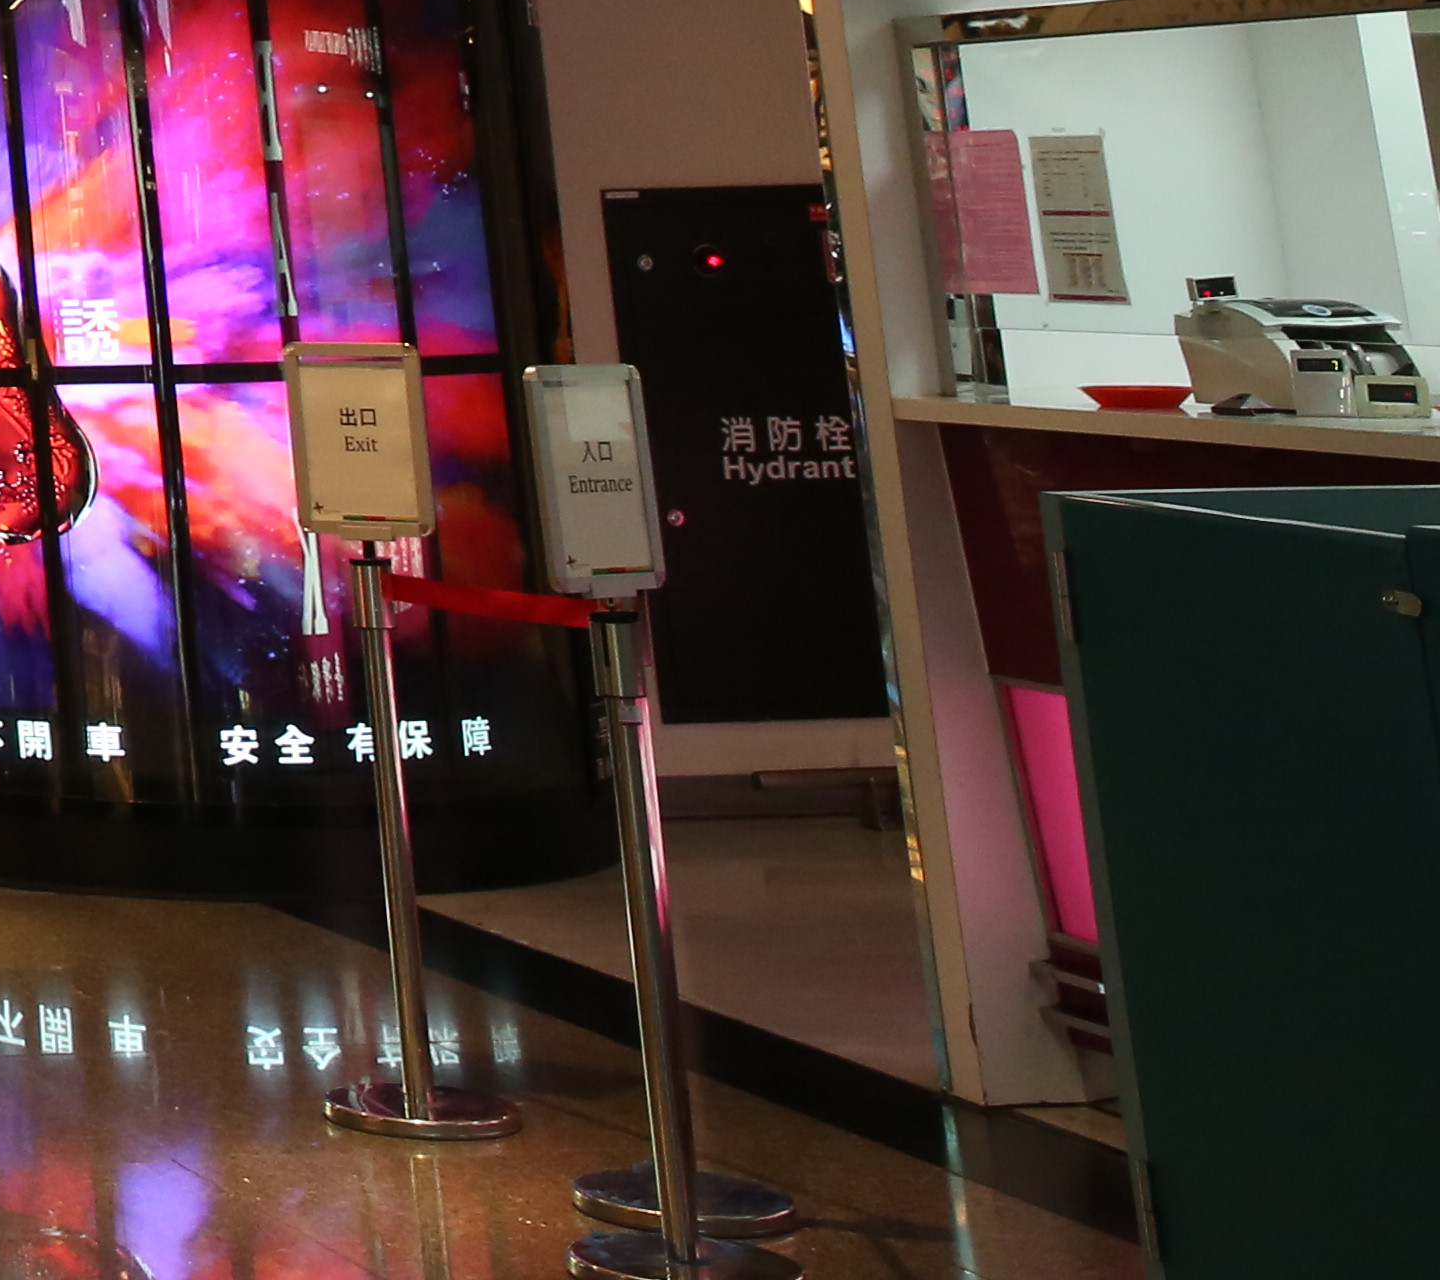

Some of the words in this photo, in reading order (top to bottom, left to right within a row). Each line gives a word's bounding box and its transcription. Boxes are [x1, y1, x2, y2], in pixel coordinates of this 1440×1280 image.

[339, 407, 377, 427] 出口
[344, 436, 378, 453] Exit
[722, 416, 851, 452] 消防栓
[582, 440, 612, 463] 入口
[723, 453, 855, 485] Hydrant
[568, 474, 633, 495] Entrance
[220, 715, 494, 766] 安全有保障
